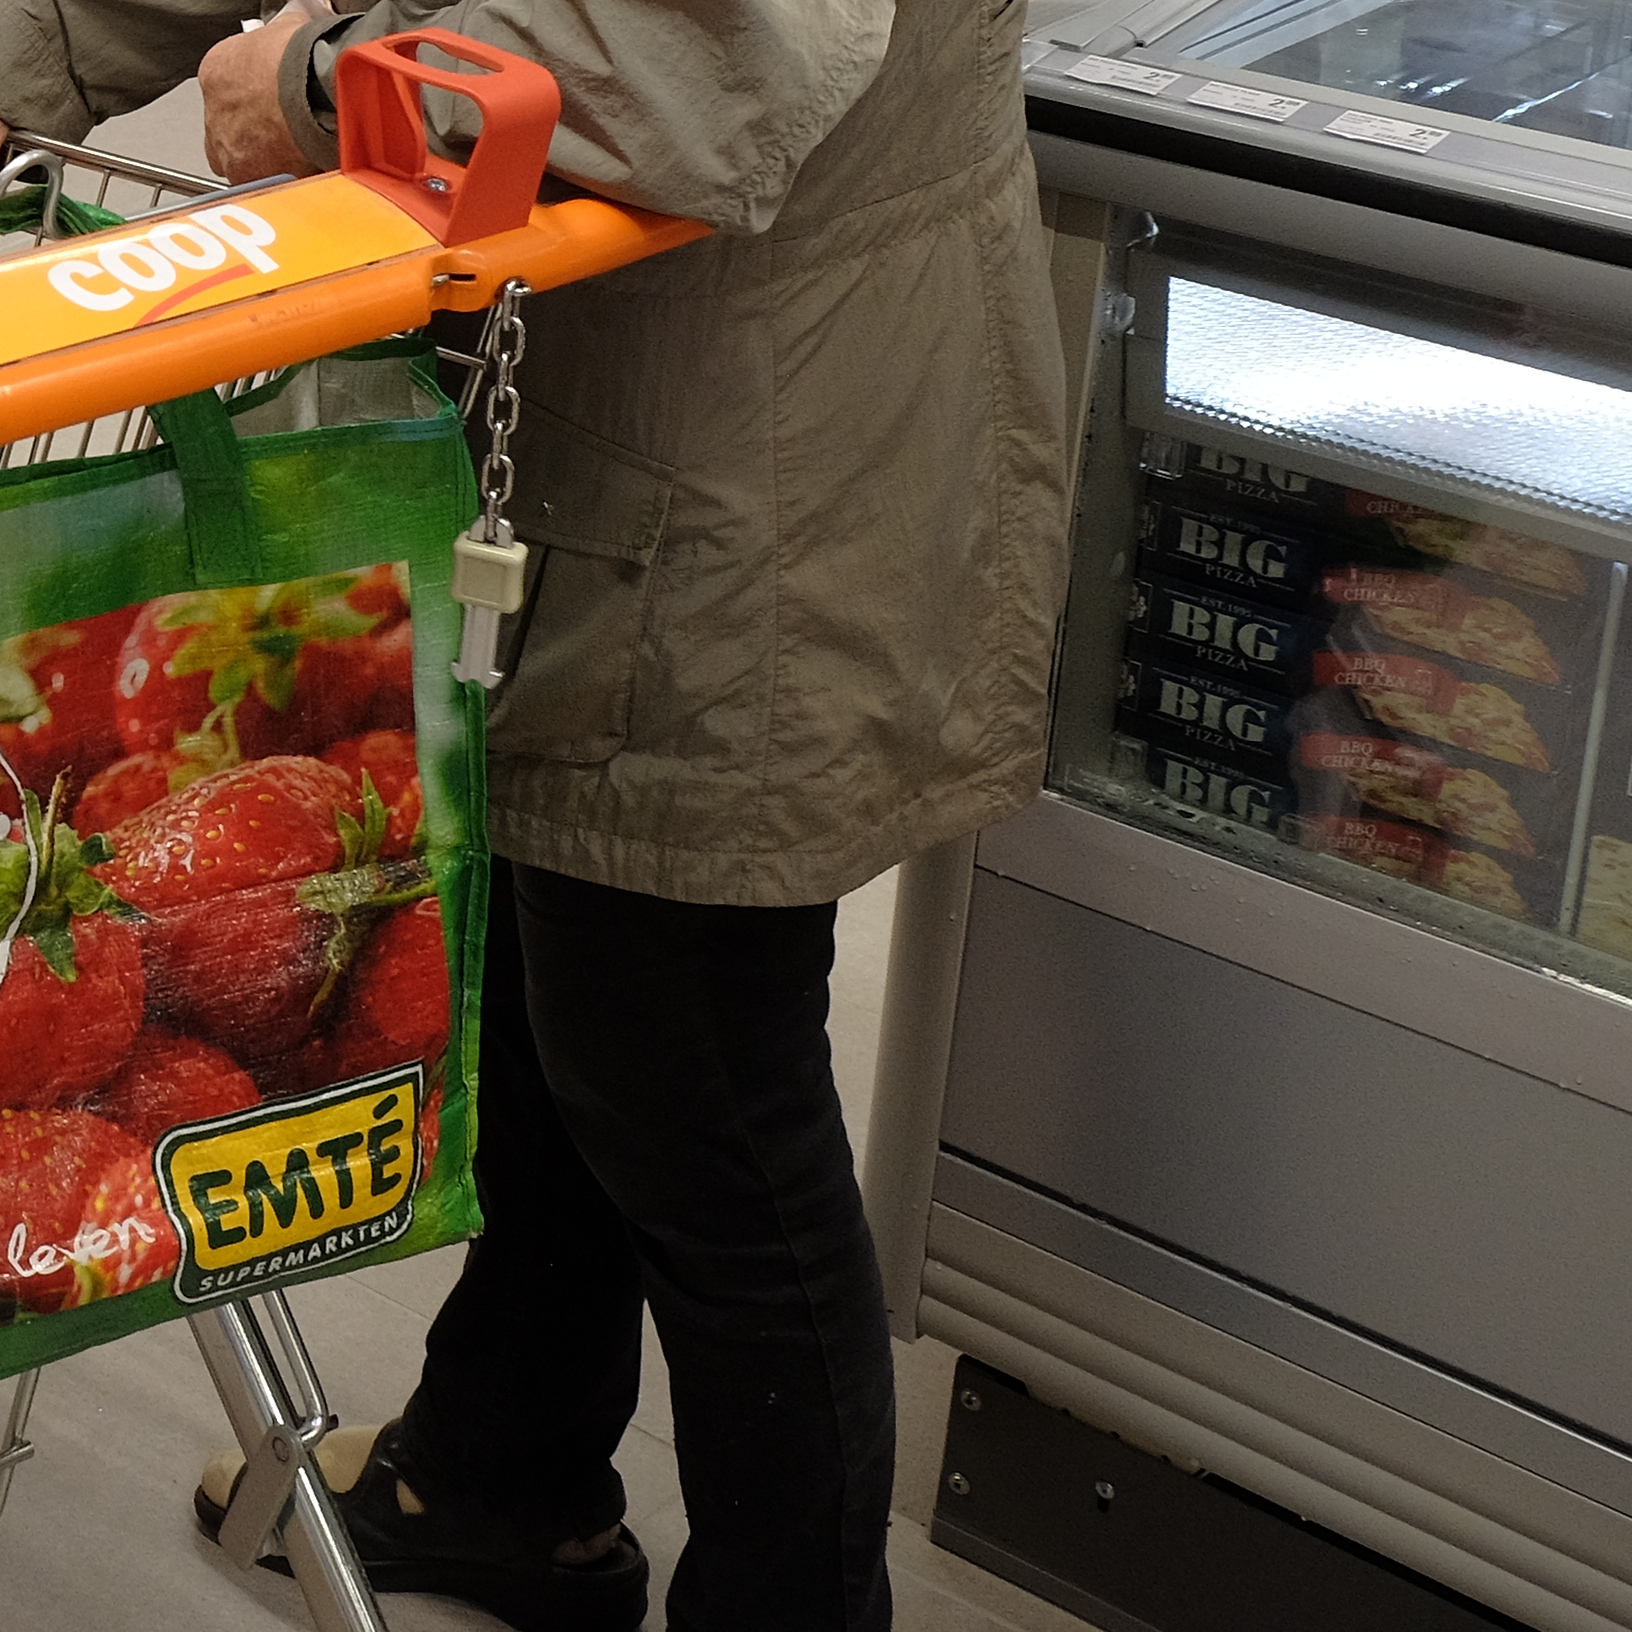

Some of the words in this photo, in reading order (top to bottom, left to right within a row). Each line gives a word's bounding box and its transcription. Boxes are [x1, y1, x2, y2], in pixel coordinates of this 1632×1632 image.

[48, 201, 278, 313] coop
[1224, 477, 1281, 504] PIZZA
[1175, 516, 1288, 581] BIG
[1204, 563, 1259, 590] PIZZA
[1200, 595, 1255, 619] EST.1995
[1342, 587, 1418, 605] CHICKEN
[1166, 598, 1280, 663] BIG
[1195, 644, 1250, 672] PIZZA
[1352, 656, 1388, 676] BBQ
[1333, 671, 1408, 690] CHICKEN
[1156, 677, 1268, 745] BIG
[1184, 724, 1237, 752] PIZZA
[1340, 739, 1374, 757] BBQ
[1162, 757, 1271, 825] BIG
[1343, 821, 1378, 839] BBQ
[1326, 835, 1401, 856] CHICKEN
[189, 1091, 407, 1254] EMTÉ
[6, 1208, 157, 1280] leven
[196, 1211, 400, 1293] SUPERMARKTEN
